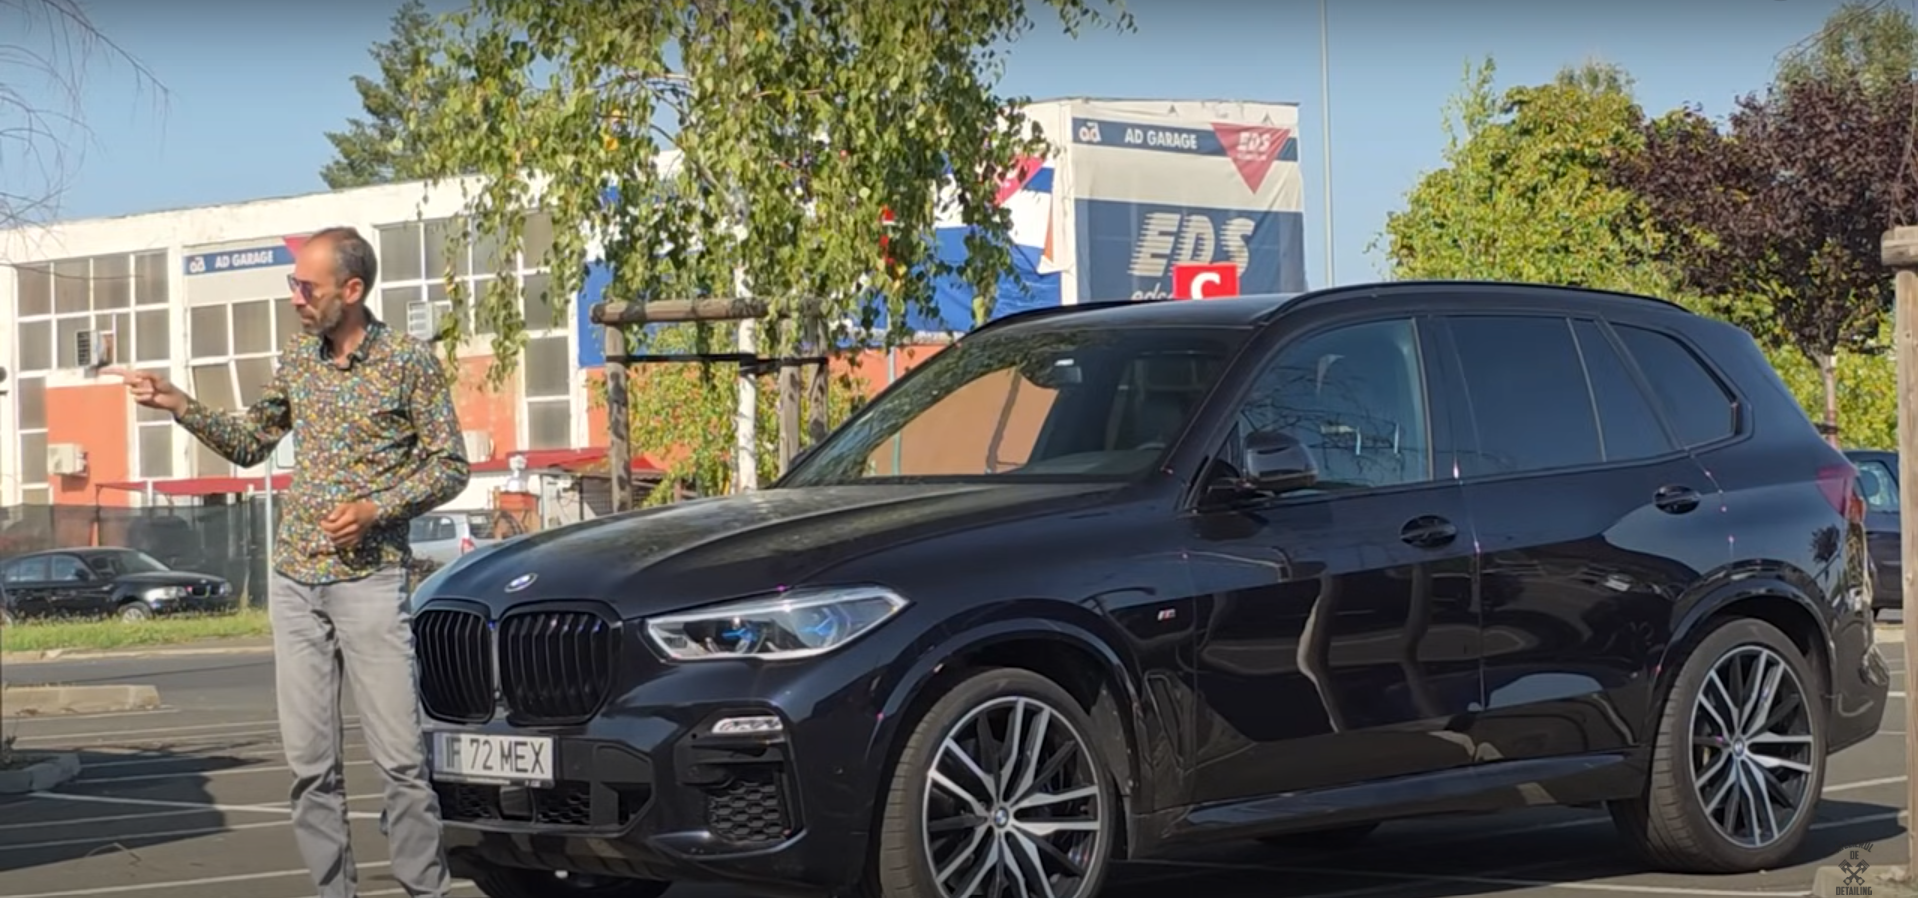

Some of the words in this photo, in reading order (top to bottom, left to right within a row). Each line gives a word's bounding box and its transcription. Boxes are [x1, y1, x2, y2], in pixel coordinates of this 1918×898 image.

[1124, 128, 1144, 144] AD
[1146, 130, 1198, 149] GARAGE
[1237, 131, 1271, 152] EDS
[1127, 212, 1255, 277] EDS
[215, 256, 230, 269] AD
[232, 250, 274, 267] GARAGE
[445, 736, 462, 769] IF
[470, 738, 494, 771] 72
[500, 740, 545, 774] MEX
